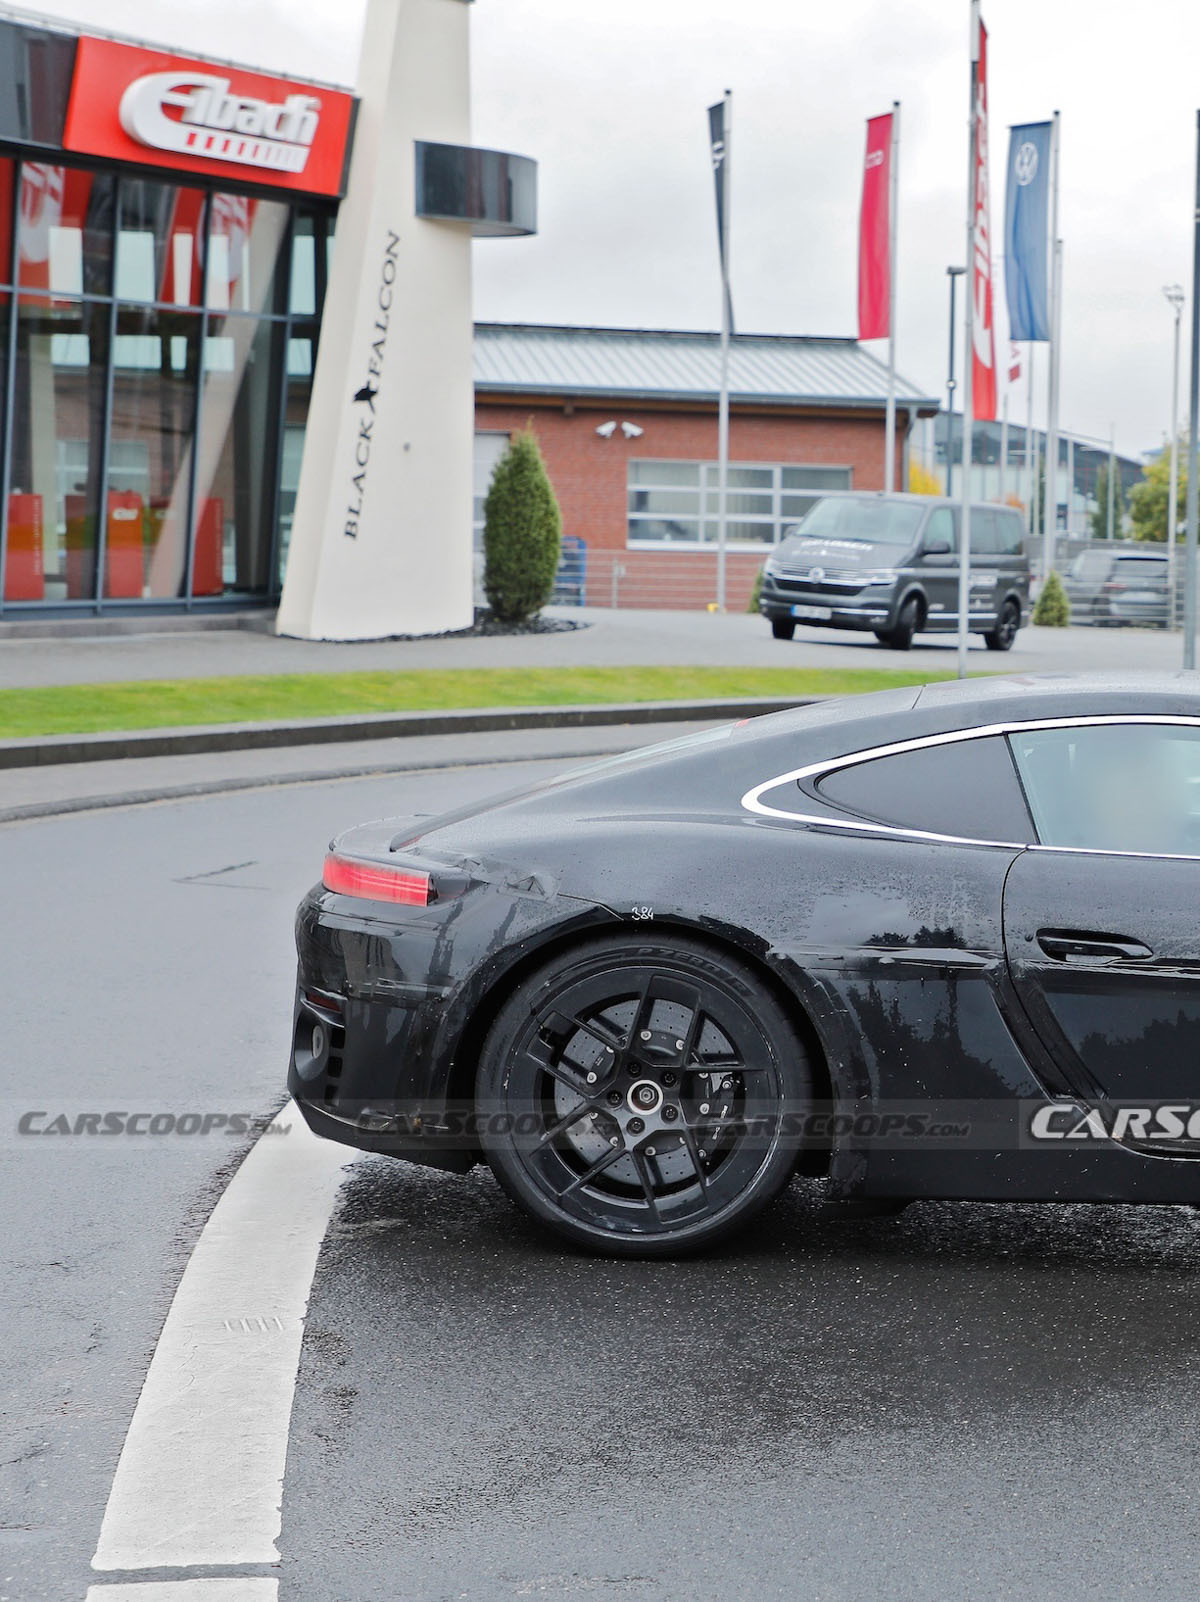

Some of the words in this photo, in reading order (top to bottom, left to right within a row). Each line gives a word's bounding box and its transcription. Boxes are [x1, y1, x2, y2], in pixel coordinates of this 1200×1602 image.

[119, 71, 321, 173] Eibach
[344, 417, 374, 540] BLACK
[368, 230, 401, 377] FALCON
[631, 906, 654, 921] 384
